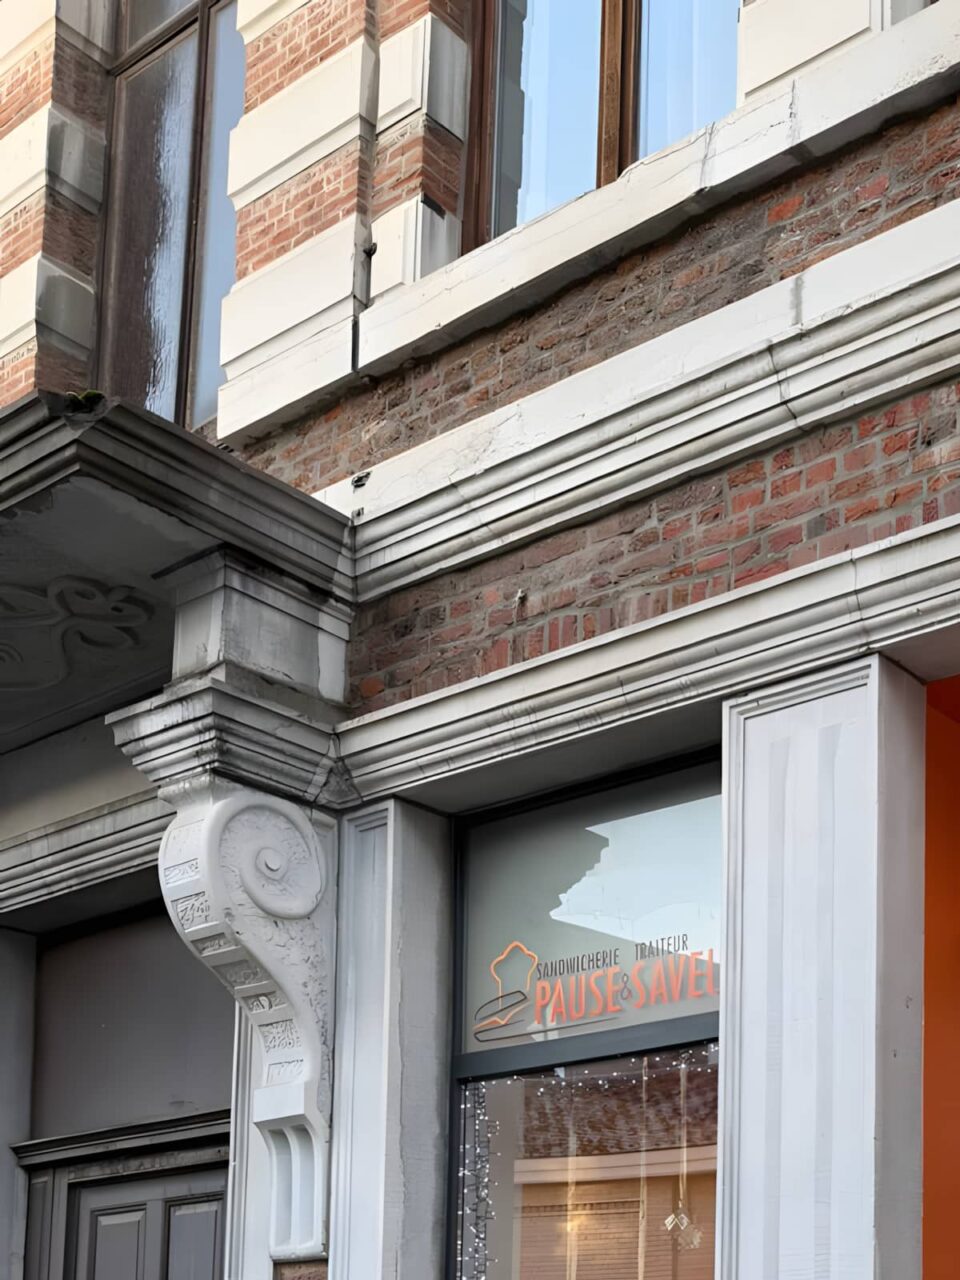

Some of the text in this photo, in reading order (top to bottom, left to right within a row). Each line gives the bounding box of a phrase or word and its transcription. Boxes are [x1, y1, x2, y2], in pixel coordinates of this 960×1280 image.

[536, 934, 688, 980] SANDWICHERIE TRAITEUR
[534, 965, 623, 1025] PAUSE
[620, 972, 633, 1000] &
